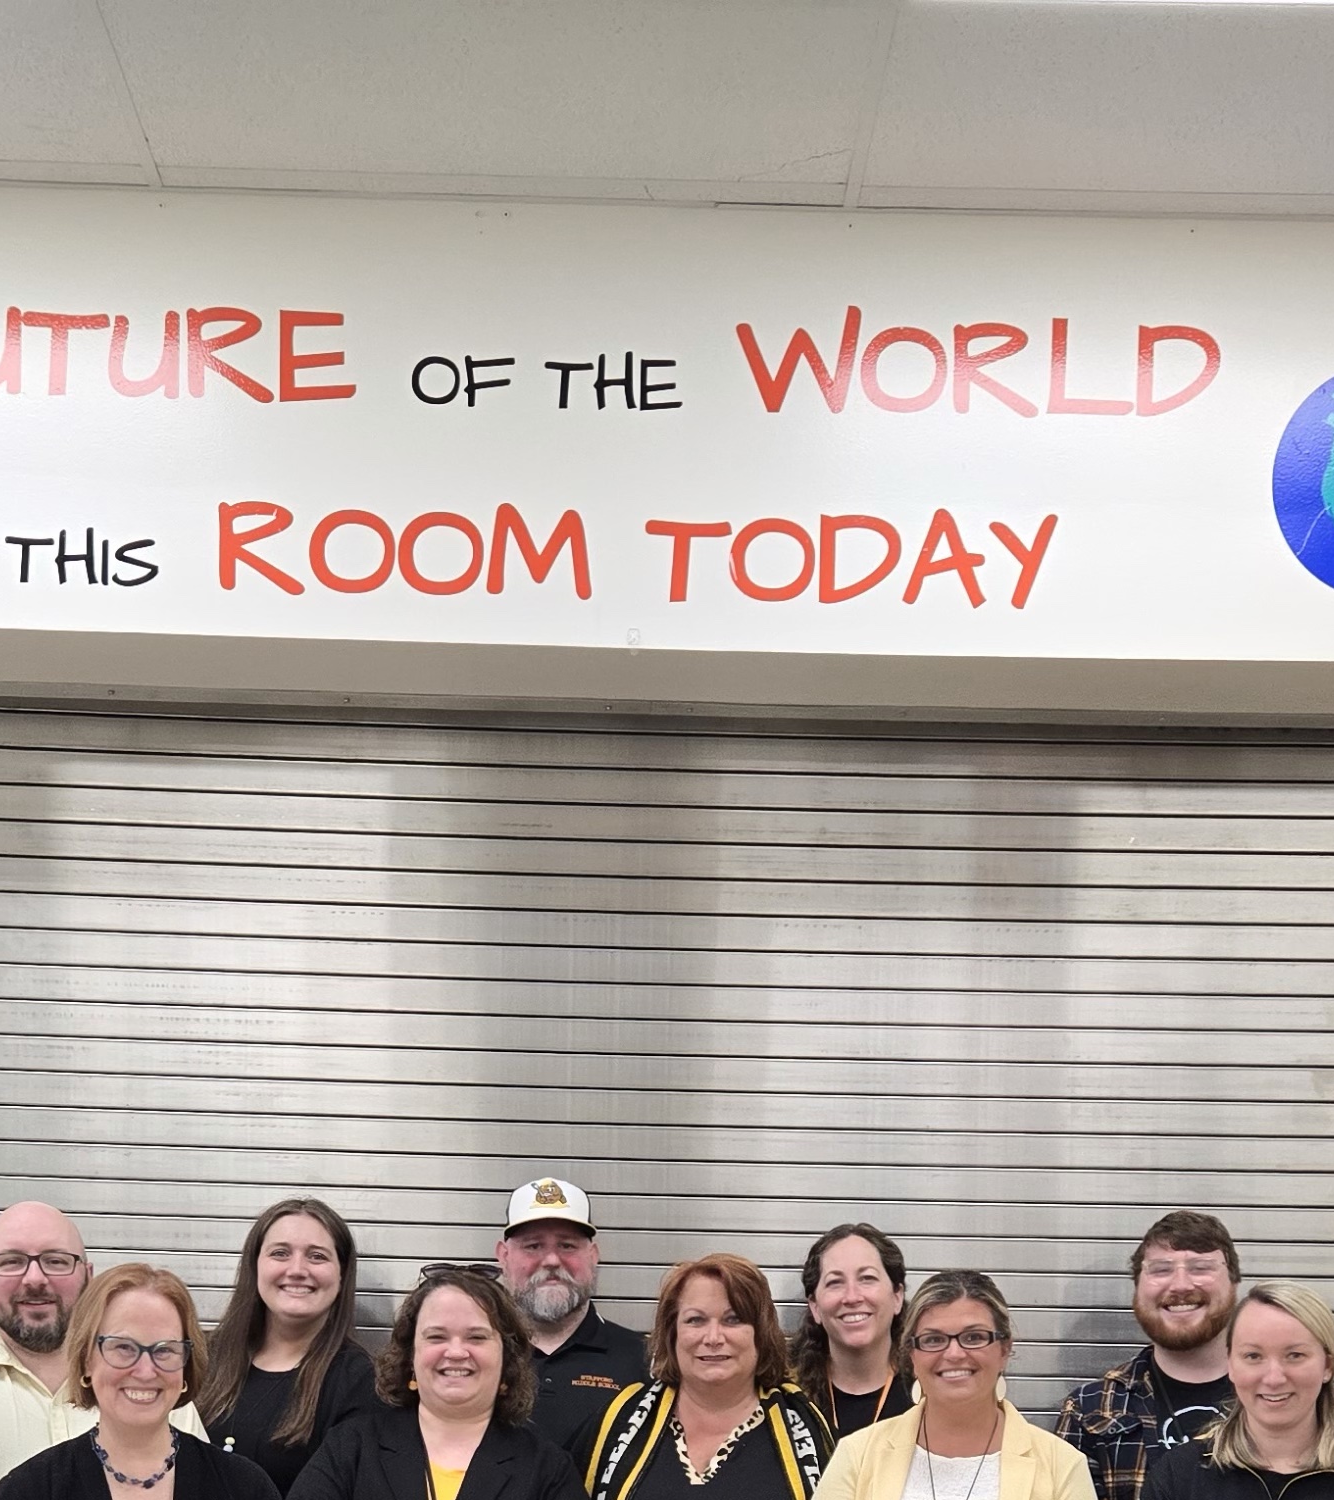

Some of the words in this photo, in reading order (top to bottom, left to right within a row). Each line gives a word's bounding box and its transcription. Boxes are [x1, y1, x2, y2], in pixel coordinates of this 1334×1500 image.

[411, 355, 516, 408] OF
[544, 351, 683, 411] THE
[735, 304, 1221, 417] WORLD
[4, 526, 159, 588] THIS
[217, 500, 593, 601] ROOM
[644, 507, 1058, 610] TODAY
